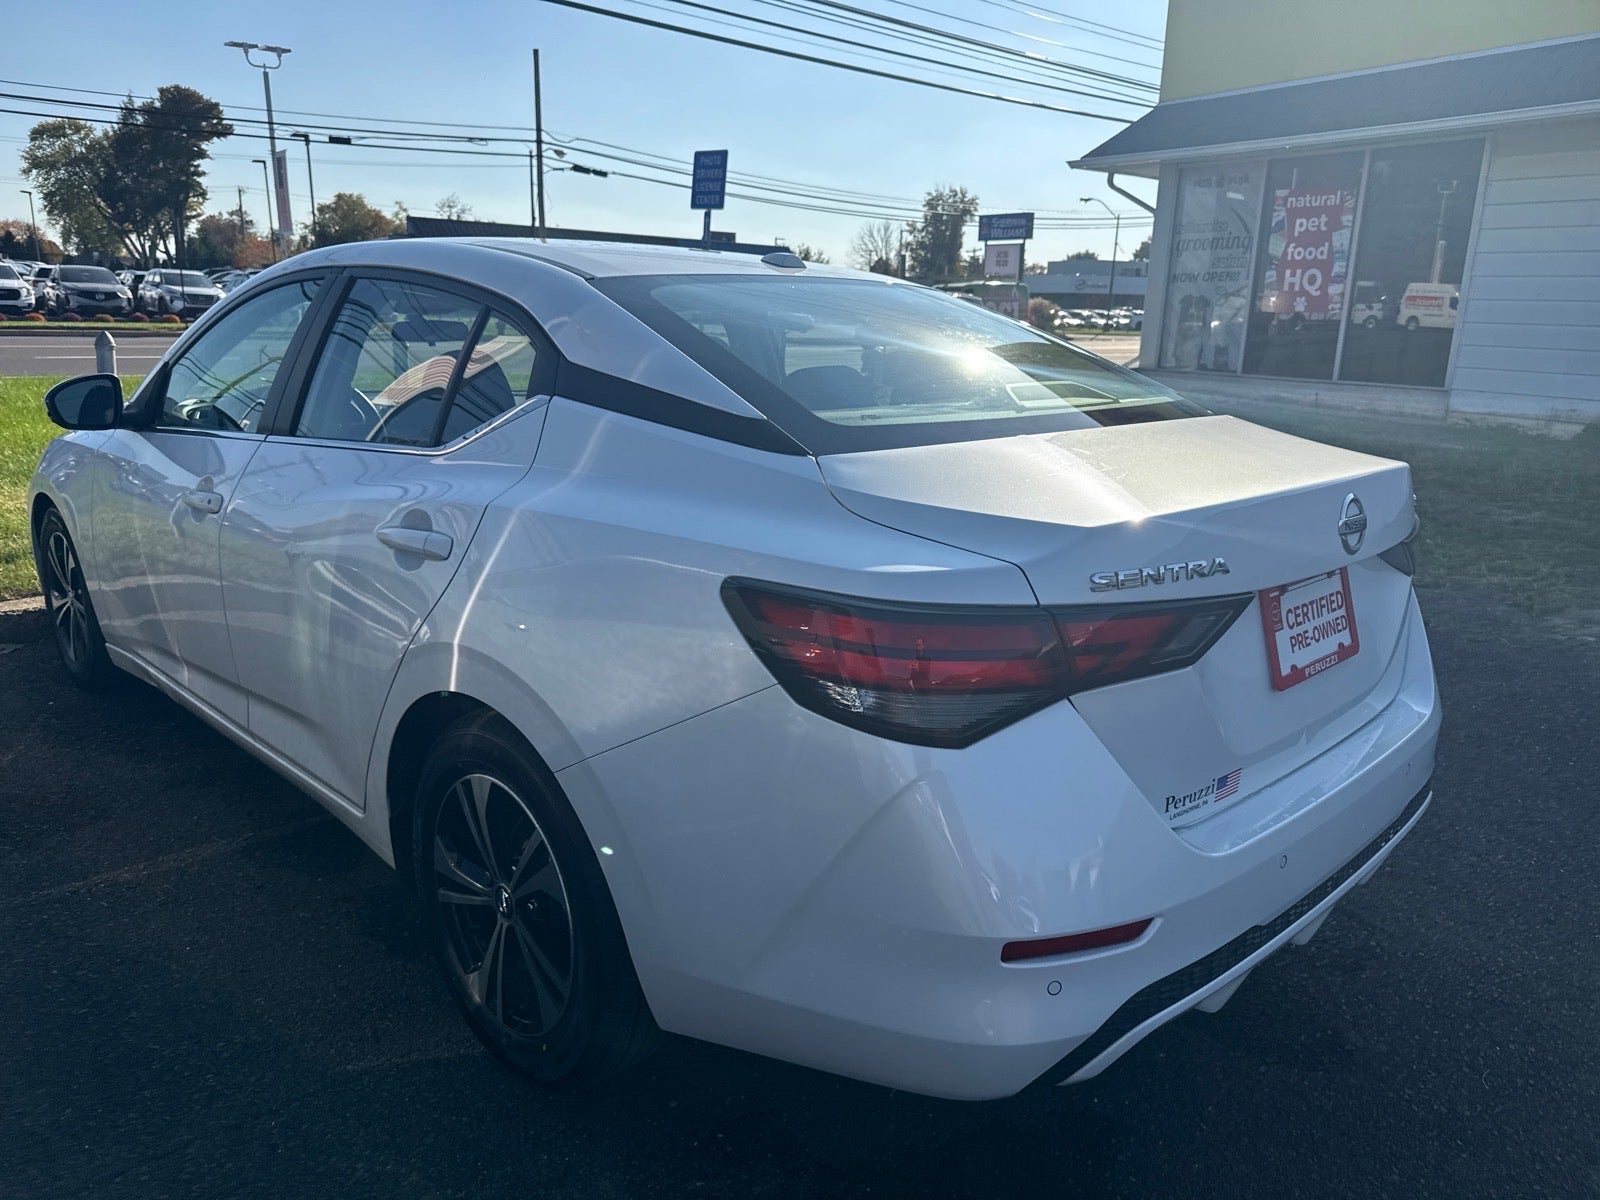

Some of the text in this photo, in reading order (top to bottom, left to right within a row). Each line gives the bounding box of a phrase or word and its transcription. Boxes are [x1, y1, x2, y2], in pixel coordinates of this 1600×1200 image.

[700, 155, 722, 166] PHOTO
[695, 181, 721, 192] LICENSE
[695, 195, 720, 205] CENTER
[1286, 190, 1341, 208] natural
[1294, 214, 1329, 237] pet
[1176, 231, 1254, 258] grooming
[1286, 242, 1329, 261] food
[1171, 272, 1200, 283] NOW
[1283, 268, 1322, 296] HQ
[1090, 557, 1230, 592] SENTRA
[1285, 590, 1344, 630] CERTIFIED
[1289, 614, 1348, 654] PRE-OWNED
[1304, 654, 1338, 678] PERUZZI
[1164, 778, 1216, 814] Peruzzi
